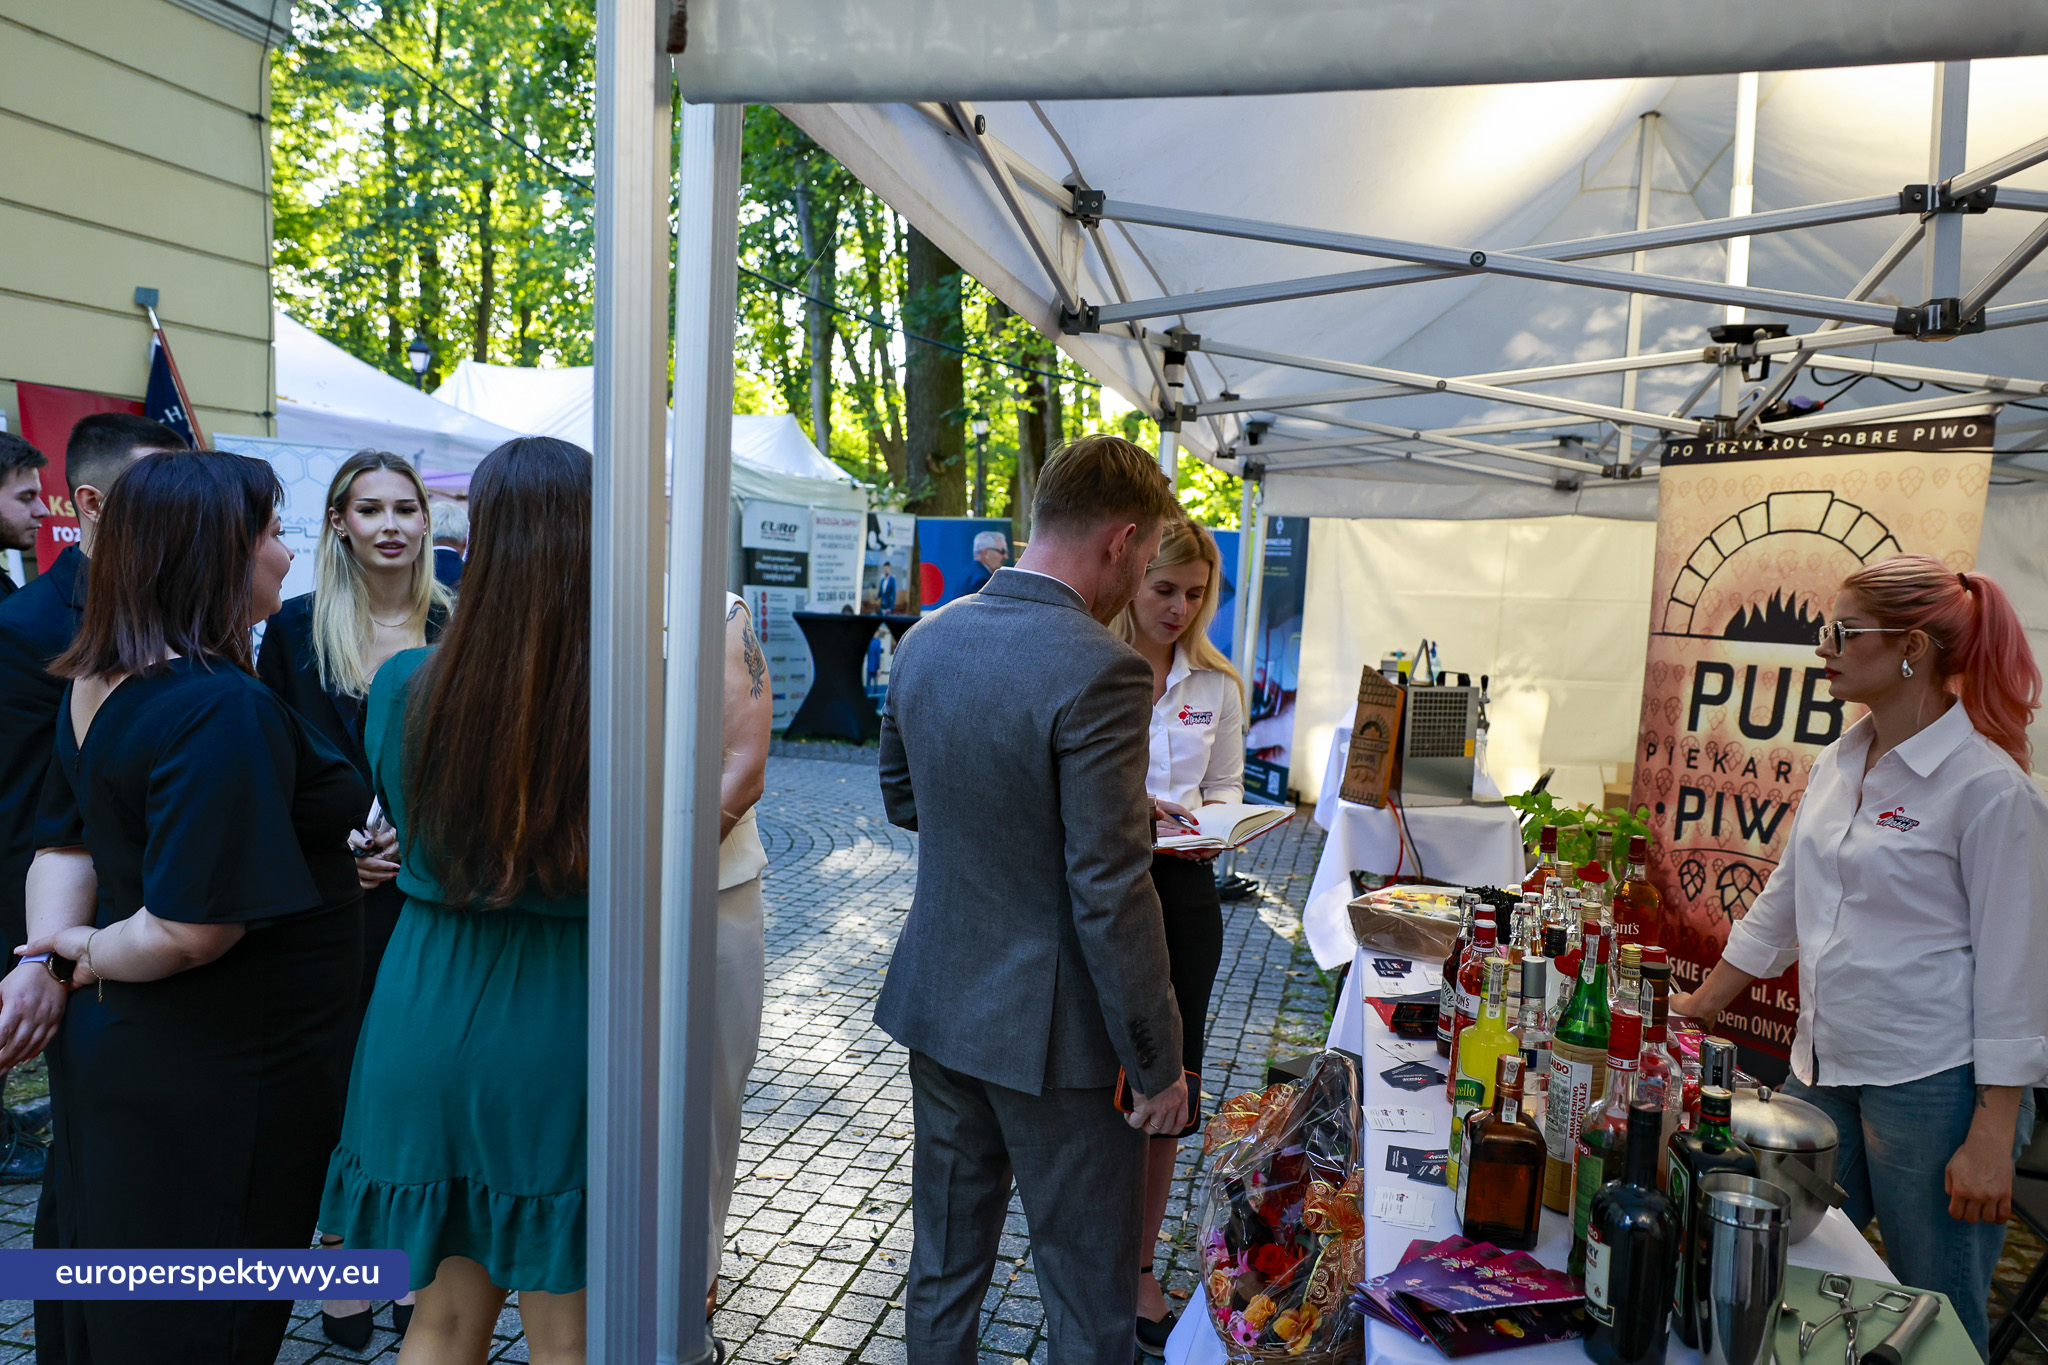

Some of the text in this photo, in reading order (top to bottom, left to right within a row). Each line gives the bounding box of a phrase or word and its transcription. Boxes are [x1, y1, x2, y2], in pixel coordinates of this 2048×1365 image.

[1670, 445, 1694, 458] PO
[1821, 429, 1899, 448] DOBRE
[1912, 423, 1979, 442] PIWO
[1688, 660, 1846, 746] PUB
[1673, 785, 1792, 845] PIW
[1751, 984, 1800, 1013] ul. Ks.
[1751, 1016, 1792, 1046] ONYX
[1569, 1086, 1579, 1139] MARASCHINO
